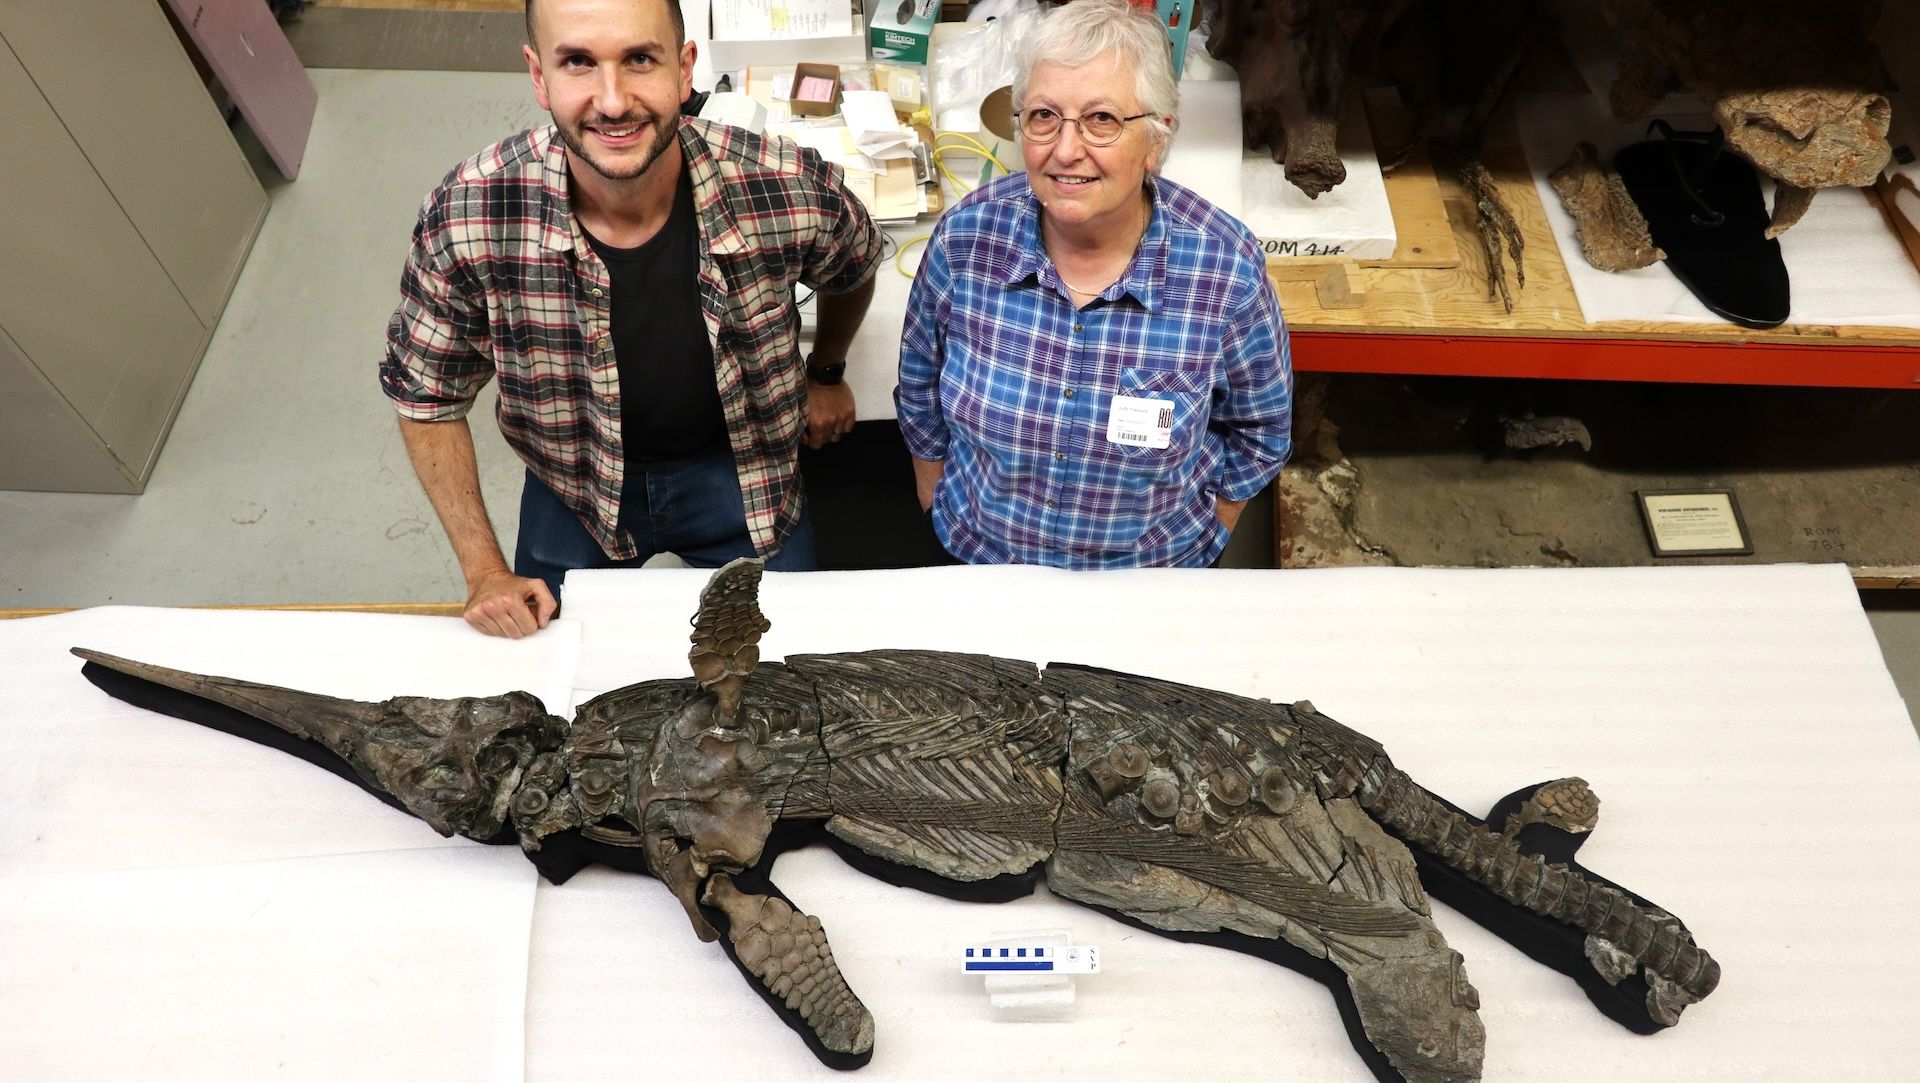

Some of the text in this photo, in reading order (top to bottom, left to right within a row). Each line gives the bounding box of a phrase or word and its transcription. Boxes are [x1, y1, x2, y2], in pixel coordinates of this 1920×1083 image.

[885, 34, 915, 44] KIMTECH
[1803, 527, 1840, 537] ROM
[1809, 539, 1846, 551] 784
